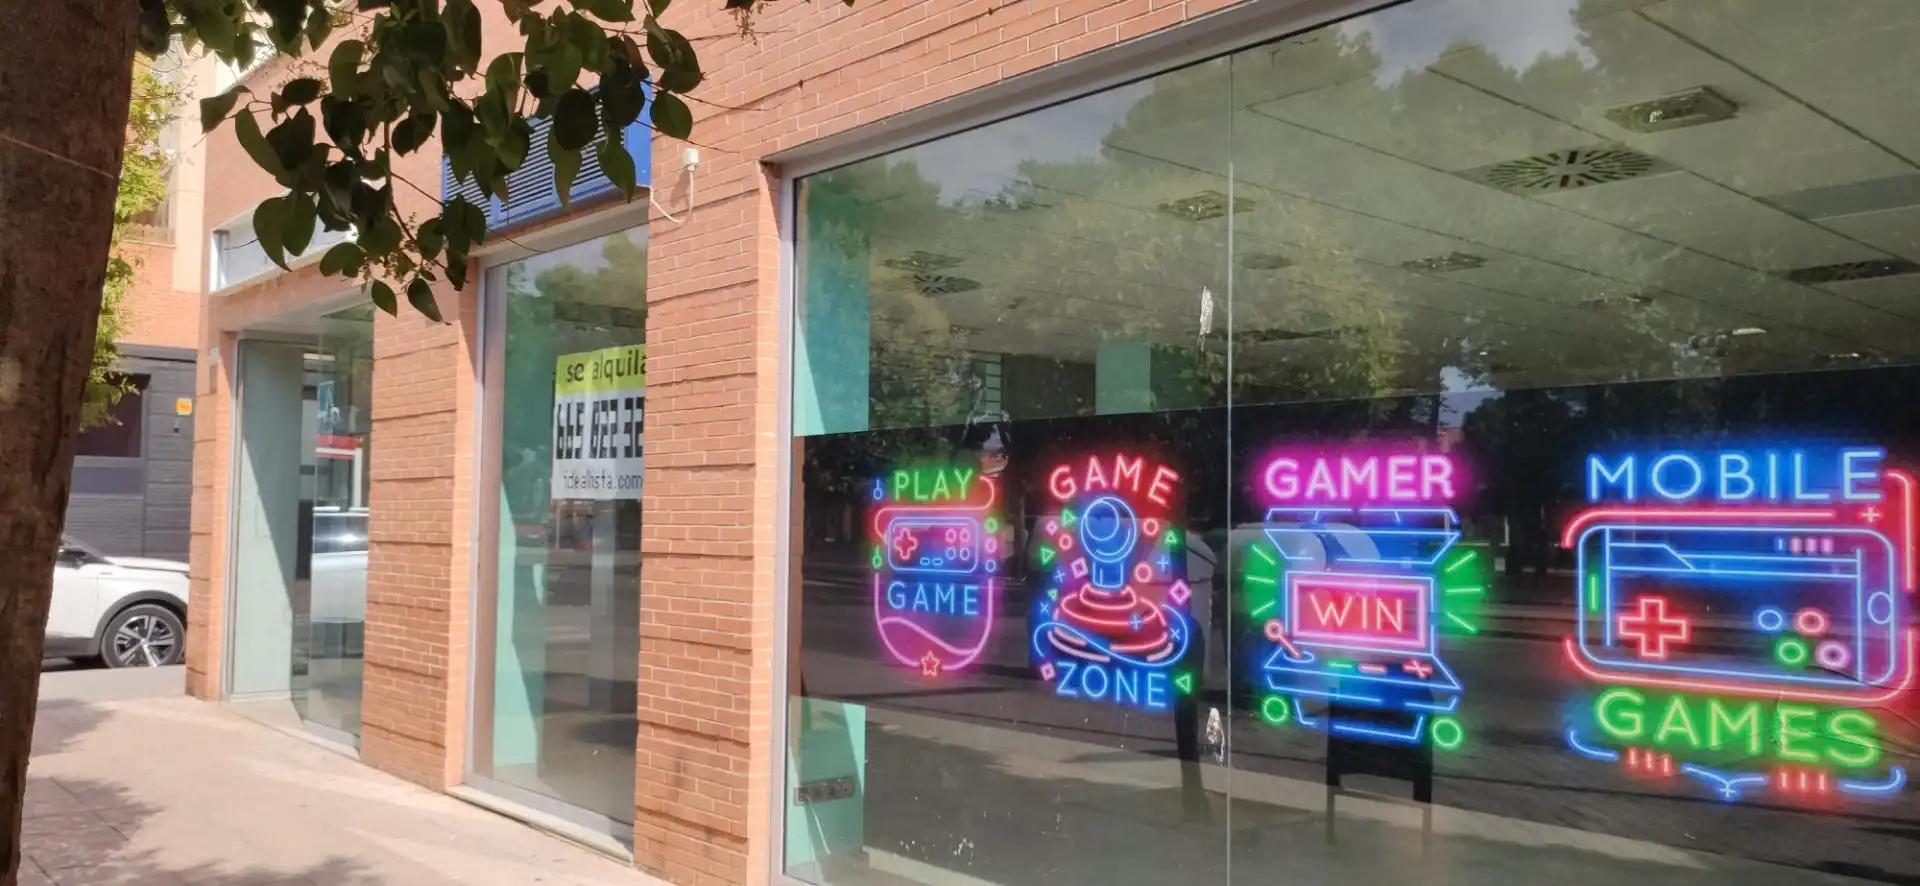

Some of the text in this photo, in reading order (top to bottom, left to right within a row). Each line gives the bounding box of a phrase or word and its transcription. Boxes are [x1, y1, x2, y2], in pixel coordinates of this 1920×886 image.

[565, 349, 646, 386] se alquila
[588, 399, 618, 459] 822
[563, 468, 643, 490] idealista.com
[893, 467, 974, 502] PLAY
[1049, 454, 1180, 505] GAME
[1264, 455, 1456, 500] GAMER
[1589, 450, 1882, 500] MOBILE
[887, 580, 979, 617] GAME
[1309, 592, 1403, 634] WIN
[1056, 660, 1167, 708] ZONE
[1596, 689, 1879, 766] GAMES
